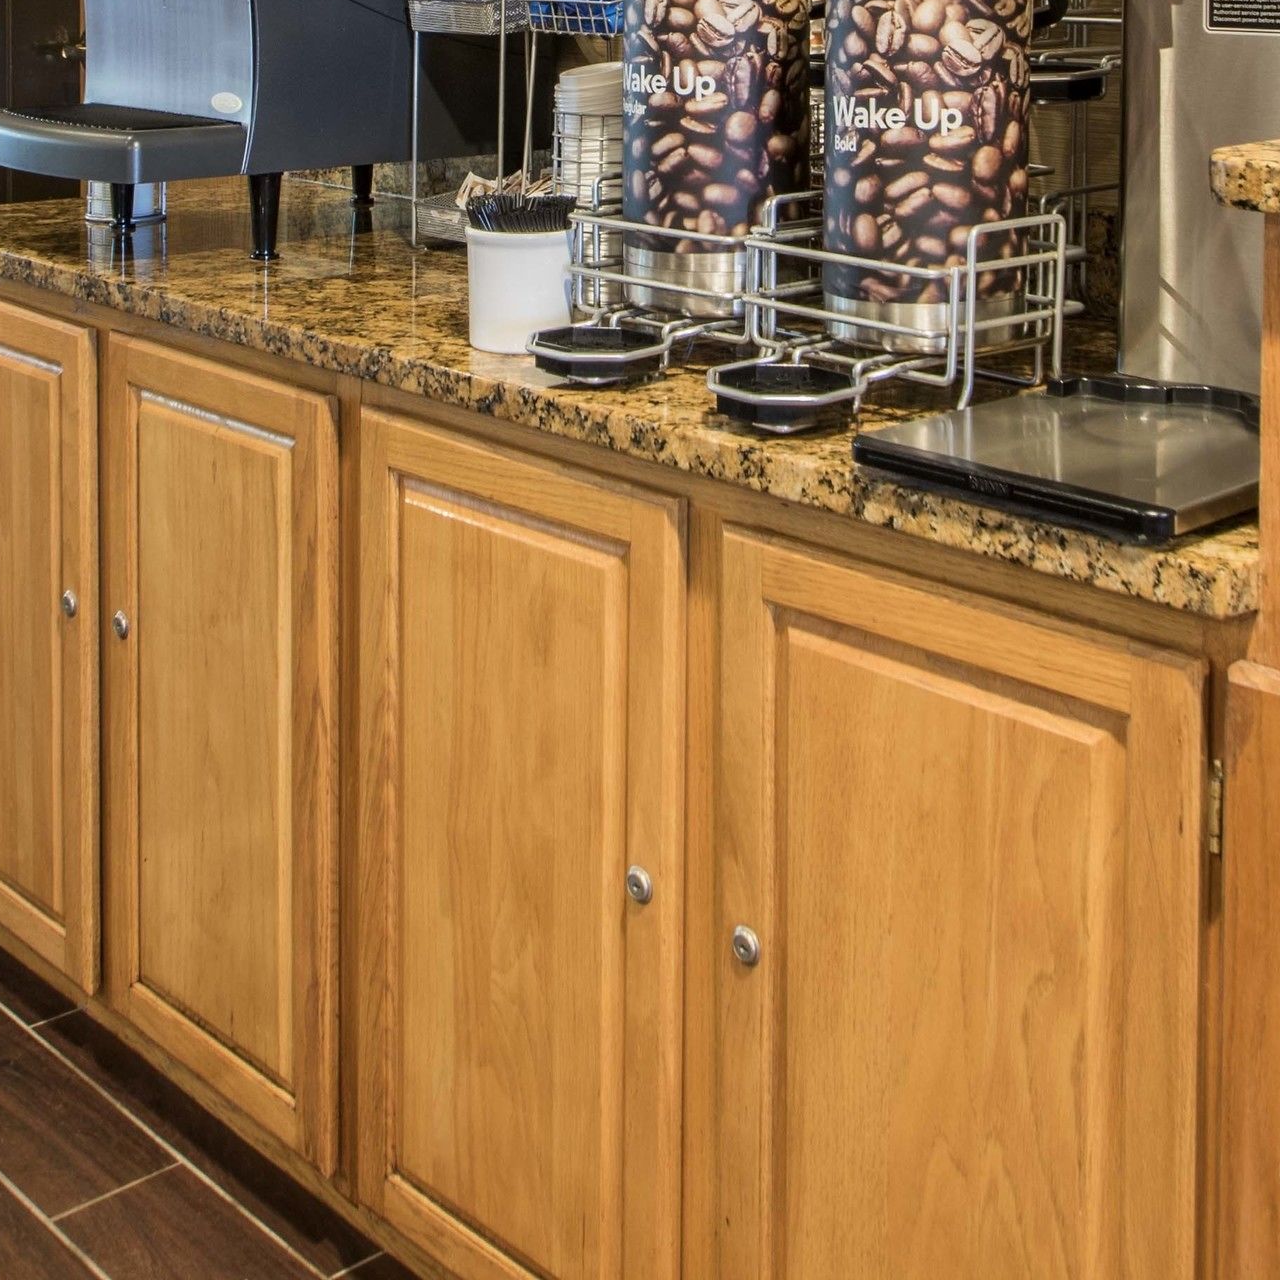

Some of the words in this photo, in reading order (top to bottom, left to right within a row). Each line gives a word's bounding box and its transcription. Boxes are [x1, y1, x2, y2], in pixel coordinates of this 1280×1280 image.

[673, 65, 717, 101] Up
[833, 96, 906, 130] Wake
[913, 97, 963, 136] Up
[834, 134, 857, 153] Bold
